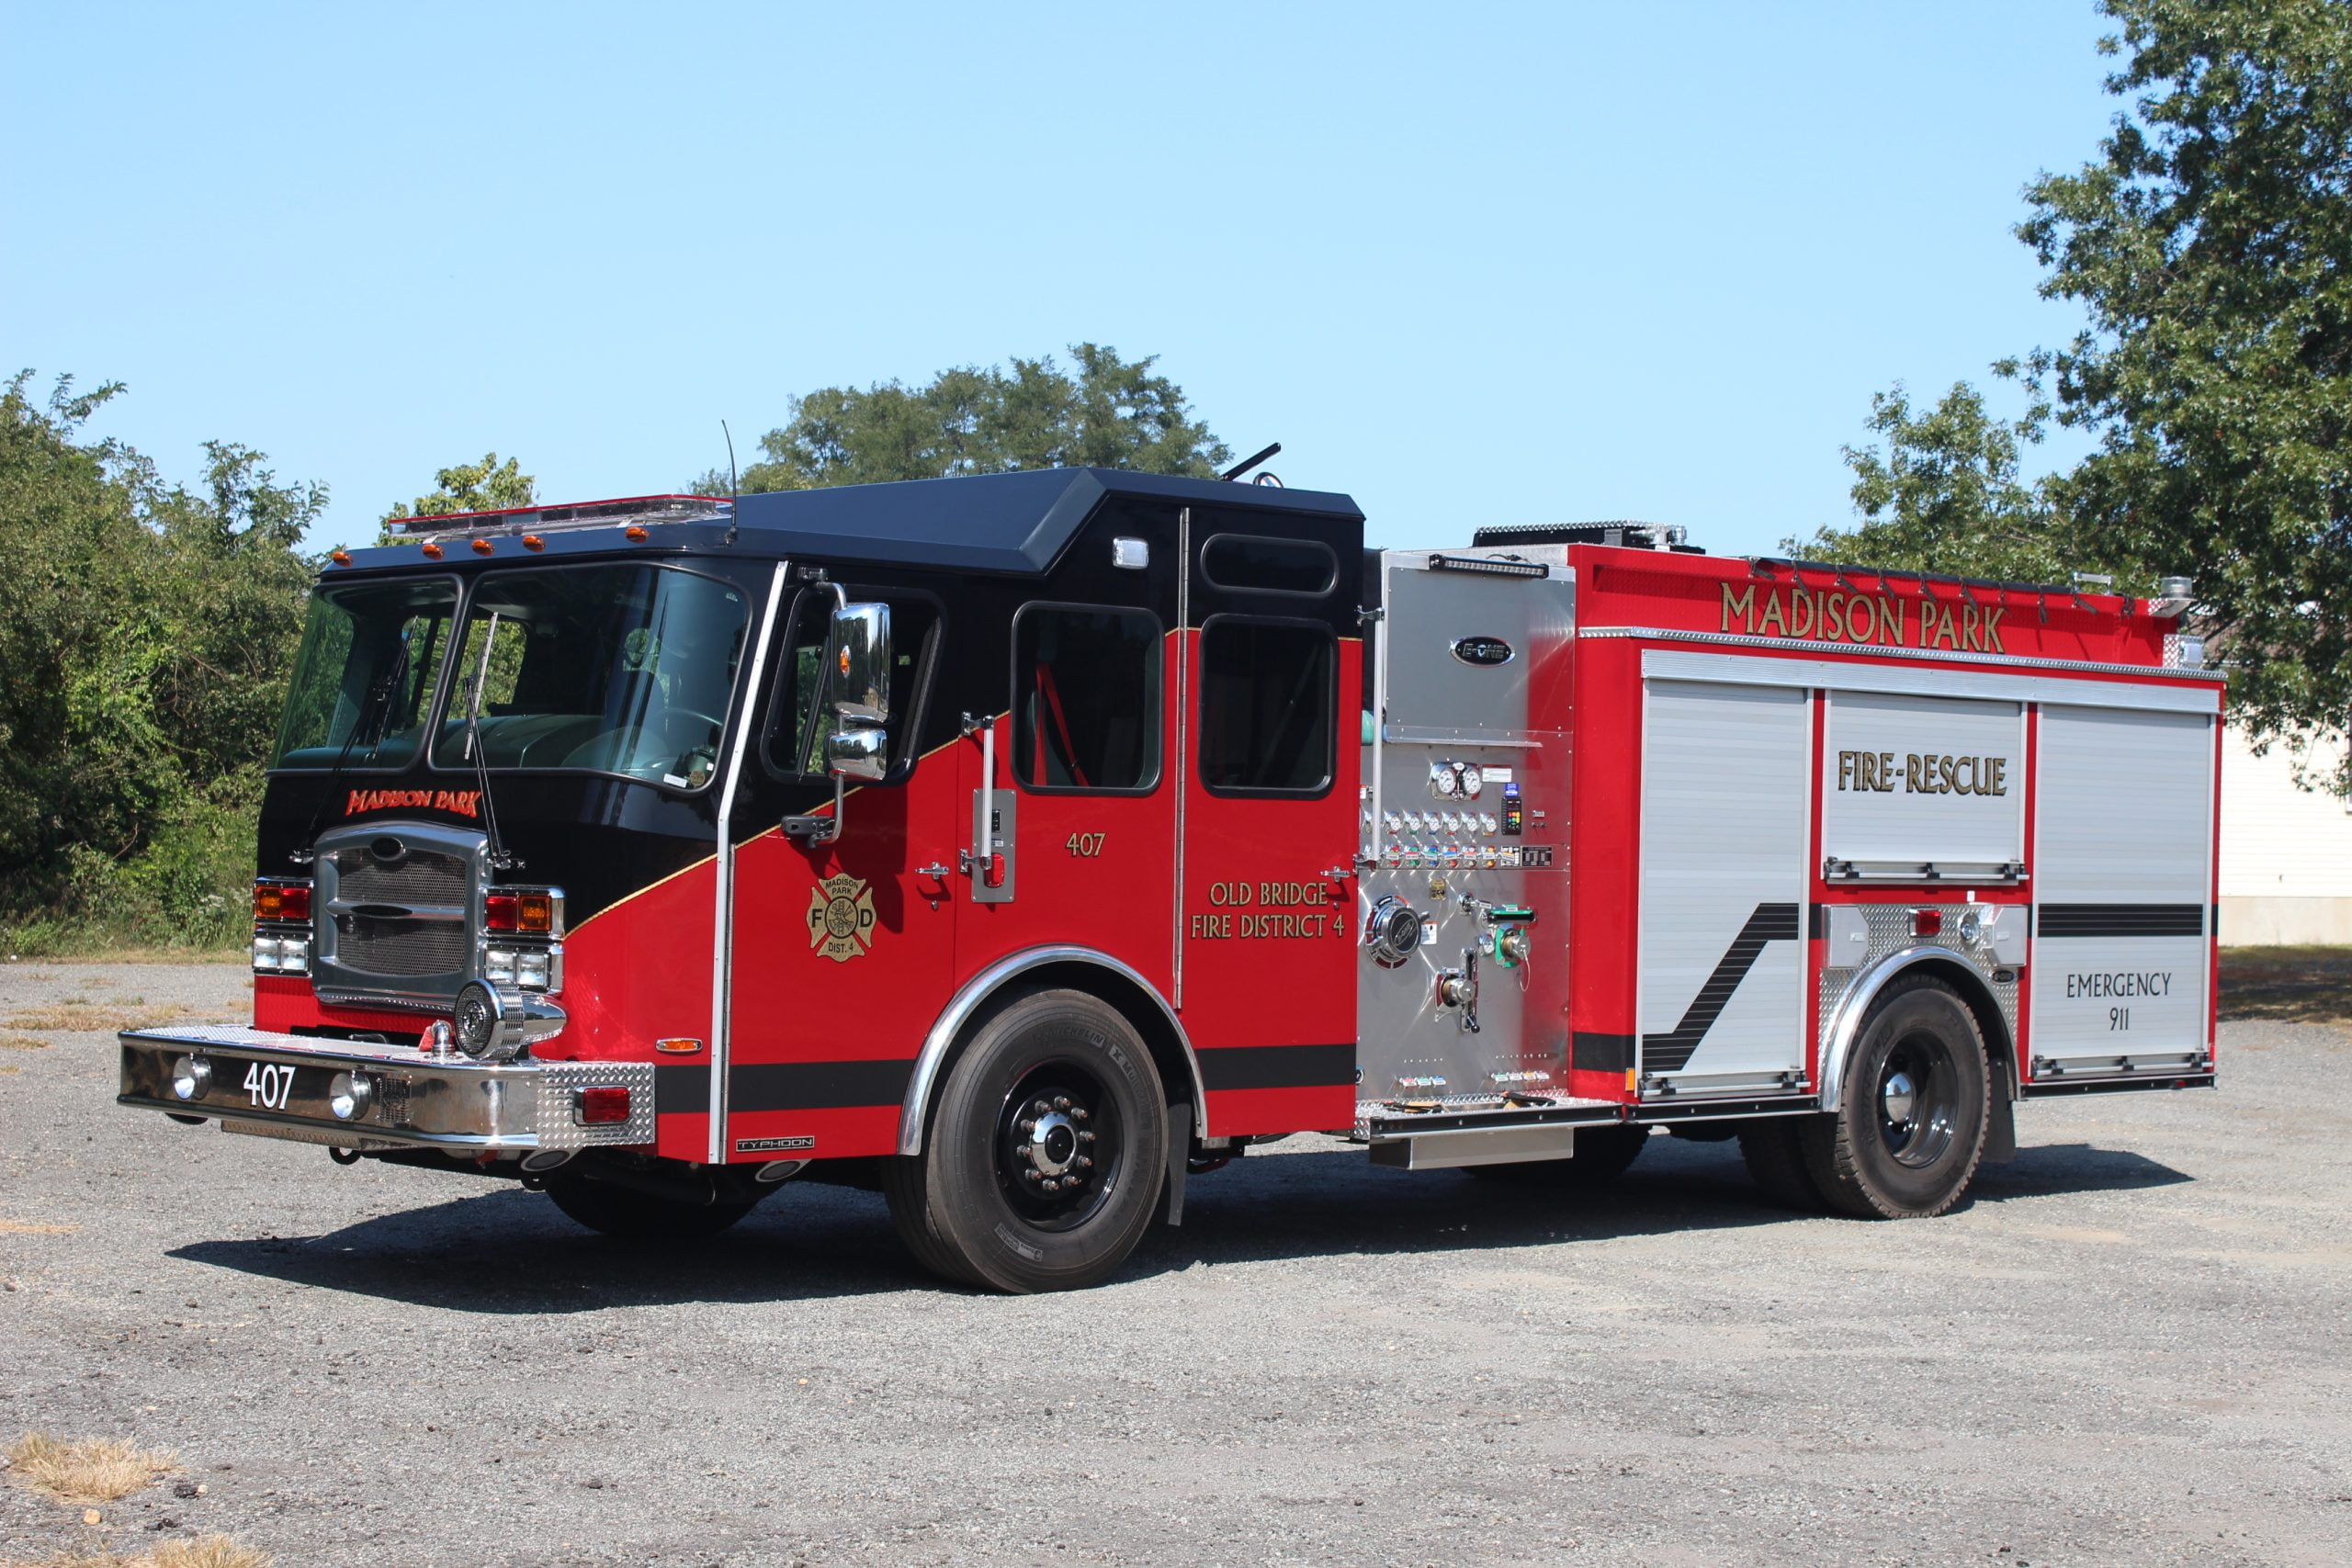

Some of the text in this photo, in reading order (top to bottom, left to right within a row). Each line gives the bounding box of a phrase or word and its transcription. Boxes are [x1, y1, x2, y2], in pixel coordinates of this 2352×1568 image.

[1720, 581, 2007, 654] MADISON PARK
[1838, 750, 2007, 796] FIRE-RESCUE
[345, 789, 481, 818] MADISON PARK
[1066, 832, 1106, 857] 407
[825, 878, 859, 890] MADISON
[831, 886, 853, 896] PARK
[1210, 882, 1329, 906] OLD BRIDGE
[1191, 914, 1345, 939] FIRE DISTRICT 4
[828, 942, 854, 953] DIST. 4
[2066, 973, 2172, 998] EMERGENCY
[2109, 1007, 2130, 1031] 911
[243, 1062, 296, 1110] 407
[738, 1138, 813, 1149] TYPHOON
